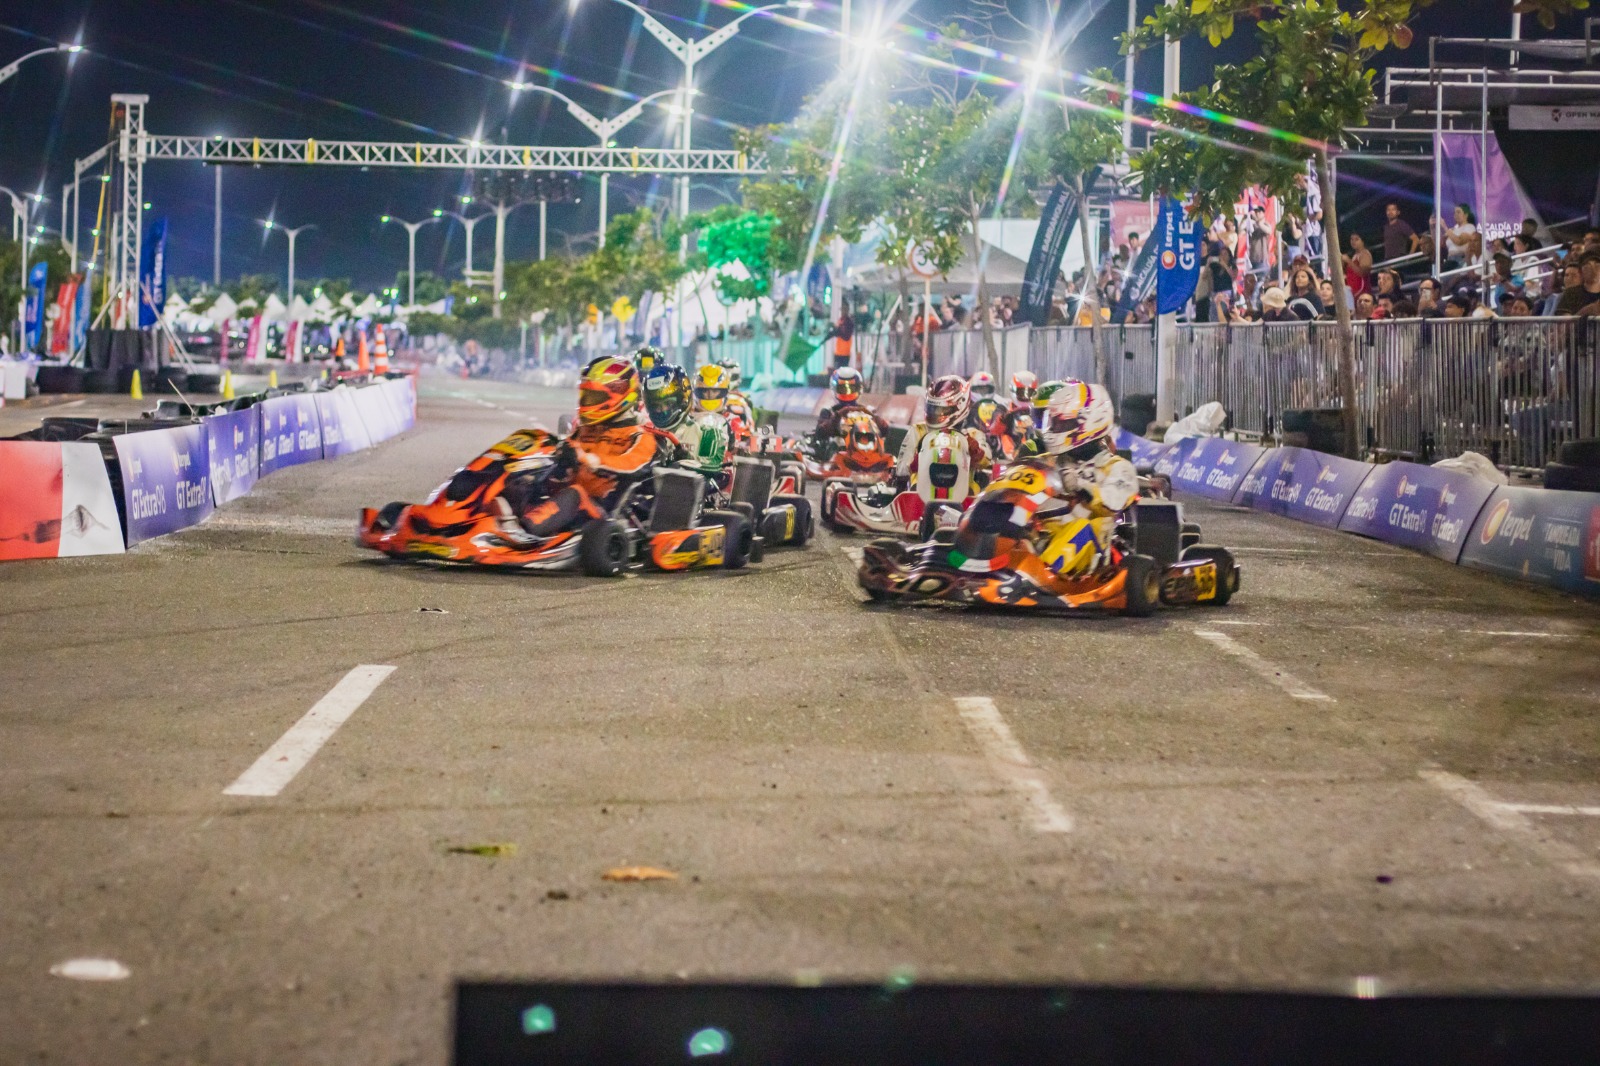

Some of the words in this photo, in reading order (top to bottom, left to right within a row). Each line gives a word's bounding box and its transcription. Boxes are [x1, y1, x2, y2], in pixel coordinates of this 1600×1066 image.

[1179, 237, 1195, 271] GT
[1389, 503, 1405, 526] GT
[1500, 511, 1536, 547] terpel
